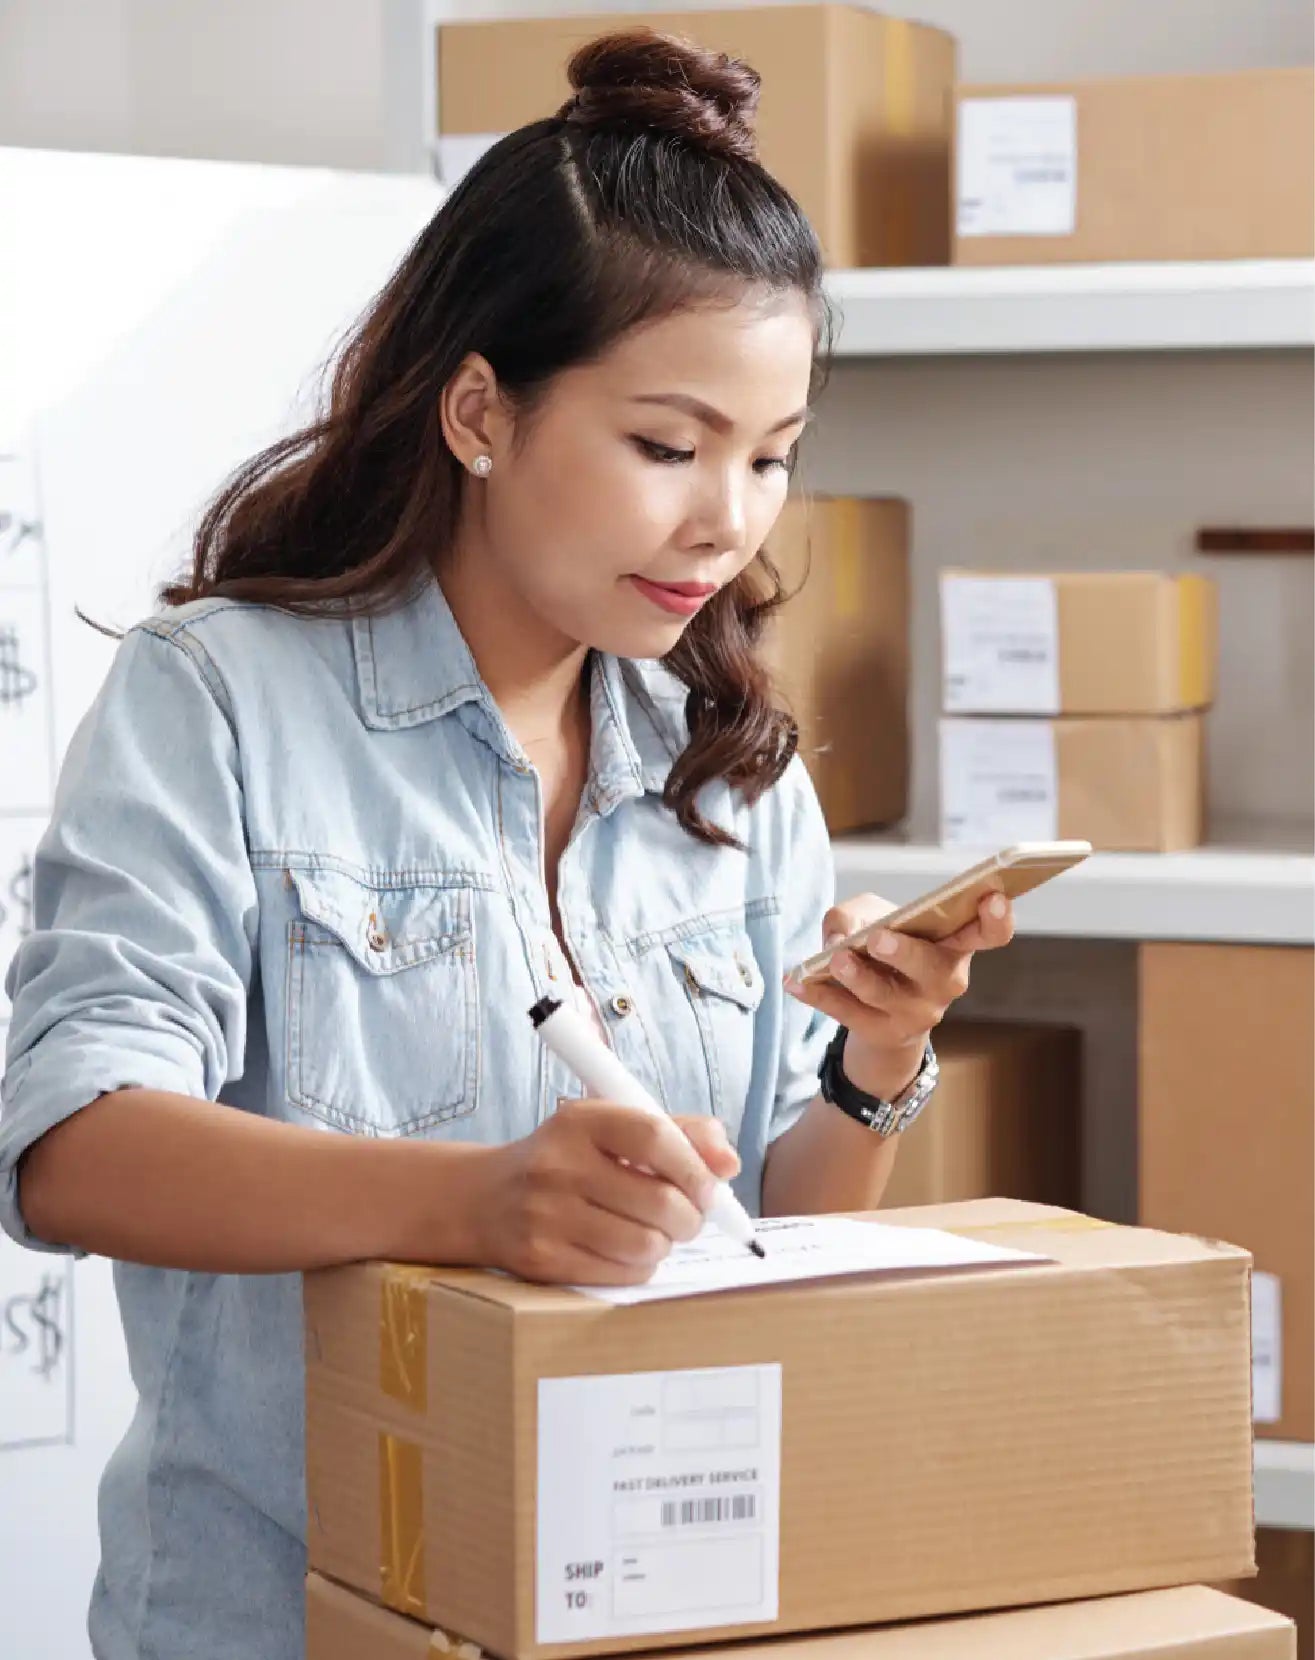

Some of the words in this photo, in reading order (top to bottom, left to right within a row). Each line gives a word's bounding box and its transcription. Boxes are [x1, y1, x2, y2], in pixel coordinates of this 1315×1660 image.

[613, 1477, 643, 1492] FAST
[646, 1472, 704, 1490] DELIVERY
[709, 1467, 759, 1484] SERVICE
[564, 1560, 605, 1581] SHIP
